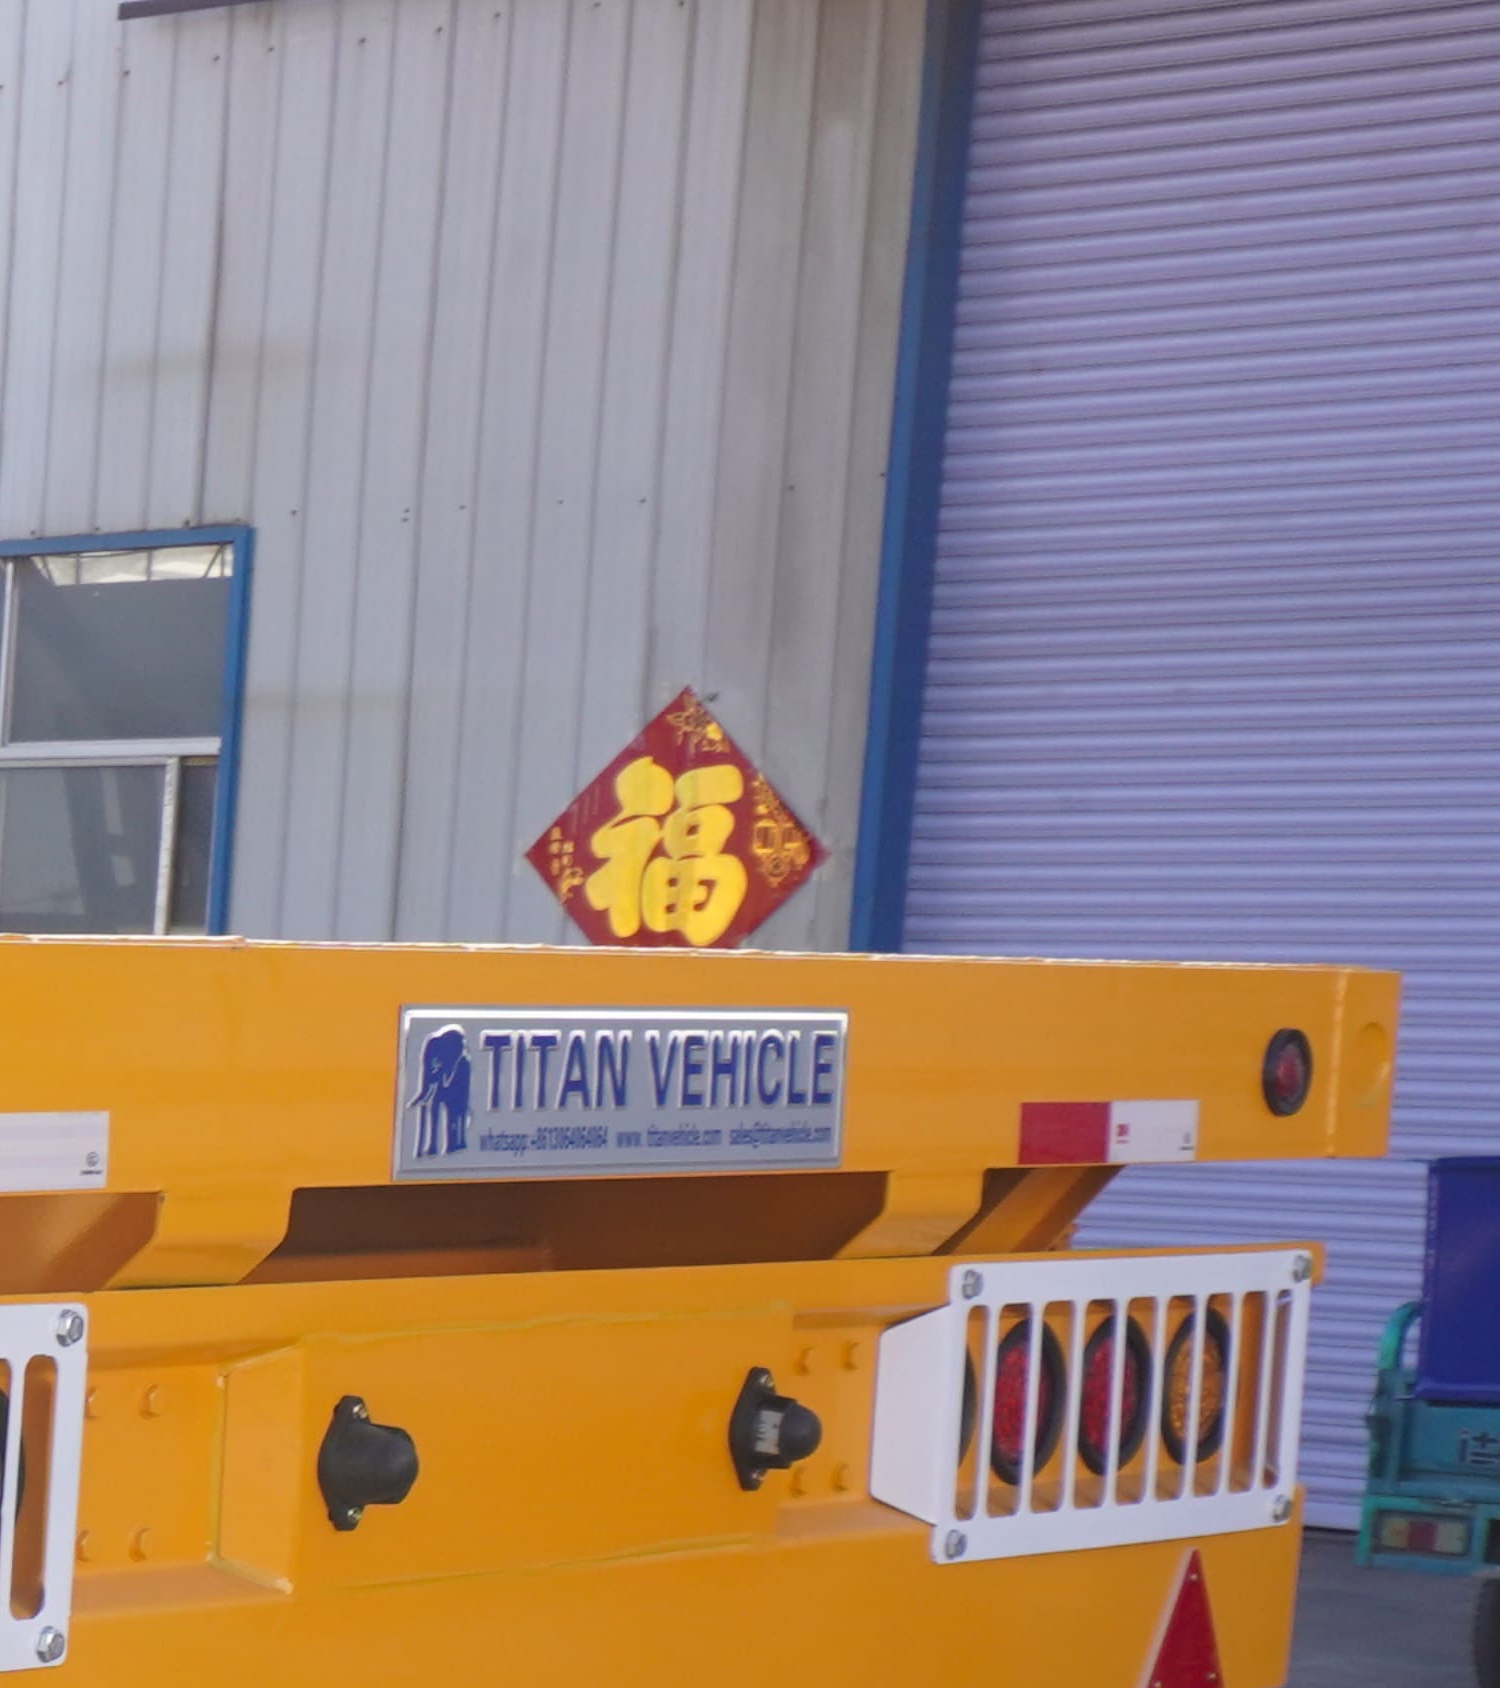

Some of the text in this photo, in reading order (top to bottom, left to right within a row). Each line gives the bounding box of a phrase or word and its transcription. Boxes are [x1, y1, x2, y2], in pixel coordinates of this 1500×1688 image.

[585, 755, 749, 947] 福
[480, 1029, 837, 1111] TITAN VEHICLE
